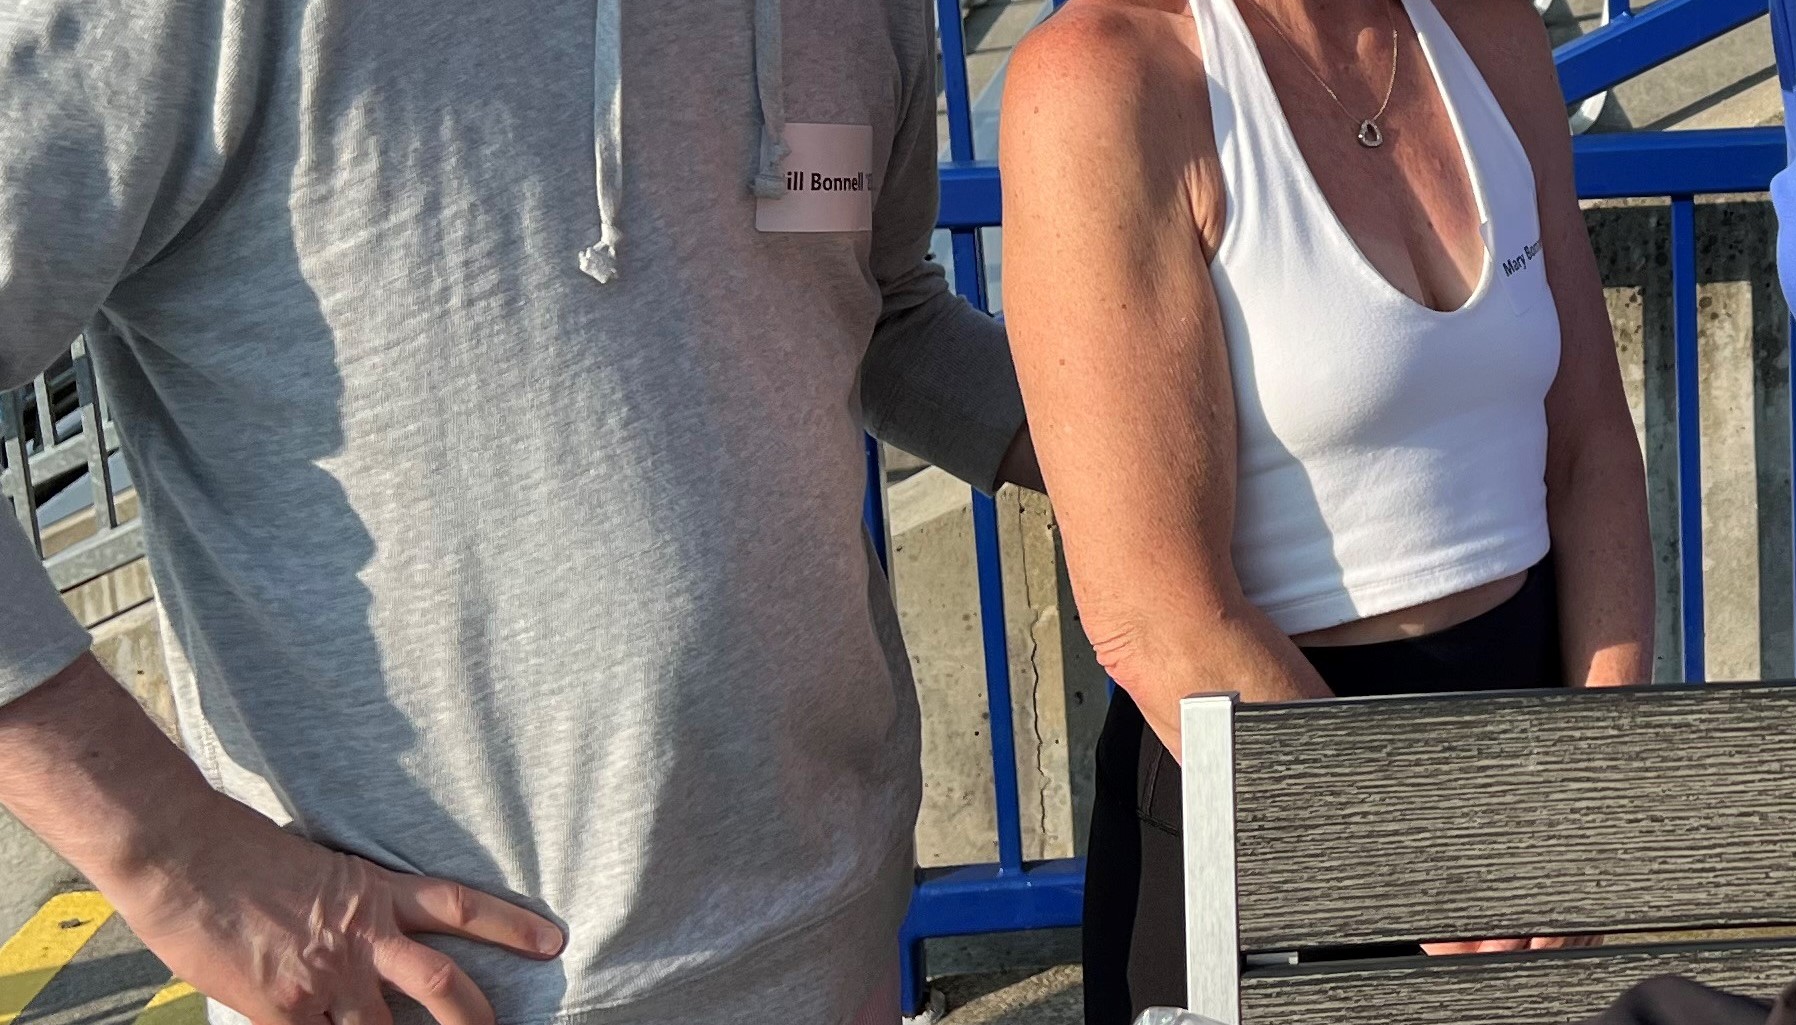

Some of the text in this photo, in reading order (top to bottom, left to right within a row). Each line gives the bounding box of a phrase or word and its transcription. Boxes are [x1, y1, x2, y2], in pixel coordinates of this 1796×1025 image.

[784, 171, 804, 191] ill
[810, 171, 864, 191] Bonnell
[1502, 253, 1527, 278] Mary
